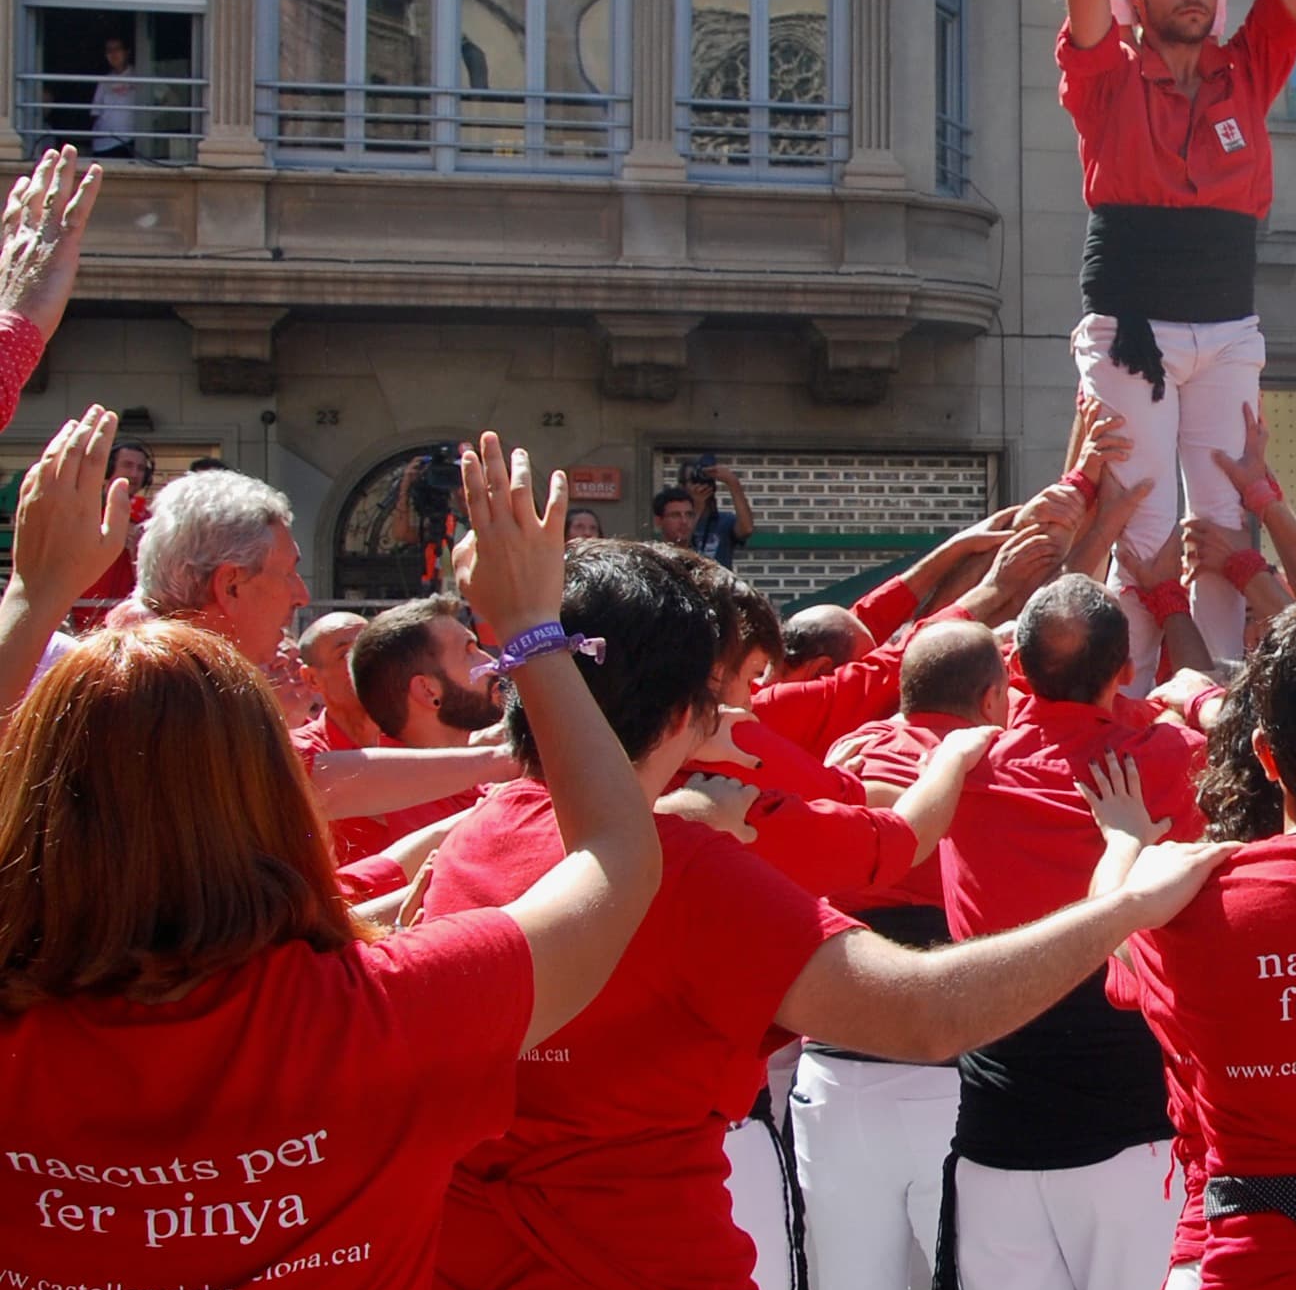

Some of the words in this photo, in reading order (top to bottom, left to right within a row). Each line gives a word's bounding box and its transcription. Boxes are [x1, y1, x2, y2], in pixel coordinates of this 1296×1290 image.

[316, 411, 340, 425] 23
[542, 413, 565, 427] 22
[520, 634, 533, 648] ET
[5, 1150, 220, 1188] nascuts
[236, 1129, 328, 1184] per
[35, 1188, 115, 1233] fer
[144, 1192, 309, 1248] pinya
